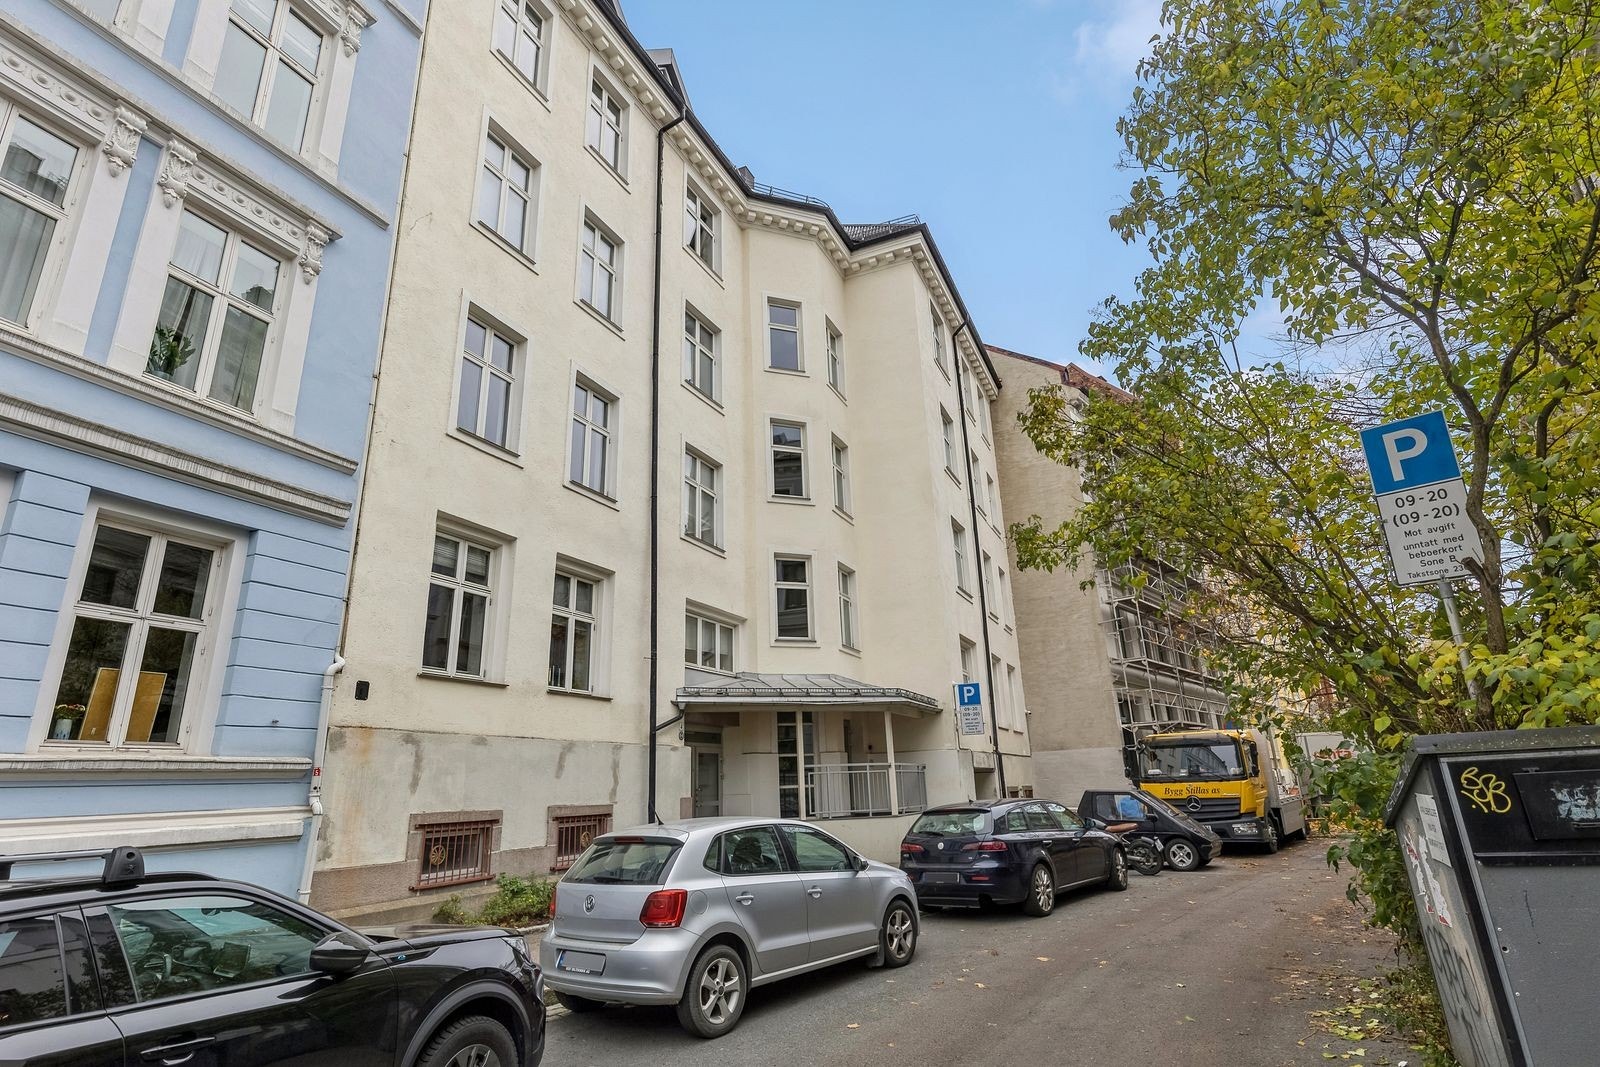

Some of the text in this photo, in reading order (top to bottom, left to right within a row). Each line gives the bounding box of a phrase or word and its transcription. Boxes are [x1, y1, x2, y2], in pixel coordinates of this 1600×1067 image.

[1382, 428, 1428, 482] P
[1404, 523, 1456, 538] Mot avgift
[1403, 534, 1464, 551] unntatt med
[1409, 544, 1463, 559] beboerkort
[1420, 554, 1457, 567] Sone B
[1407, 568, 1449, 579] Takstsone
[963, 686, 975, 703] P
[1164, 784, 1221, 797] Bygg Stillas as
